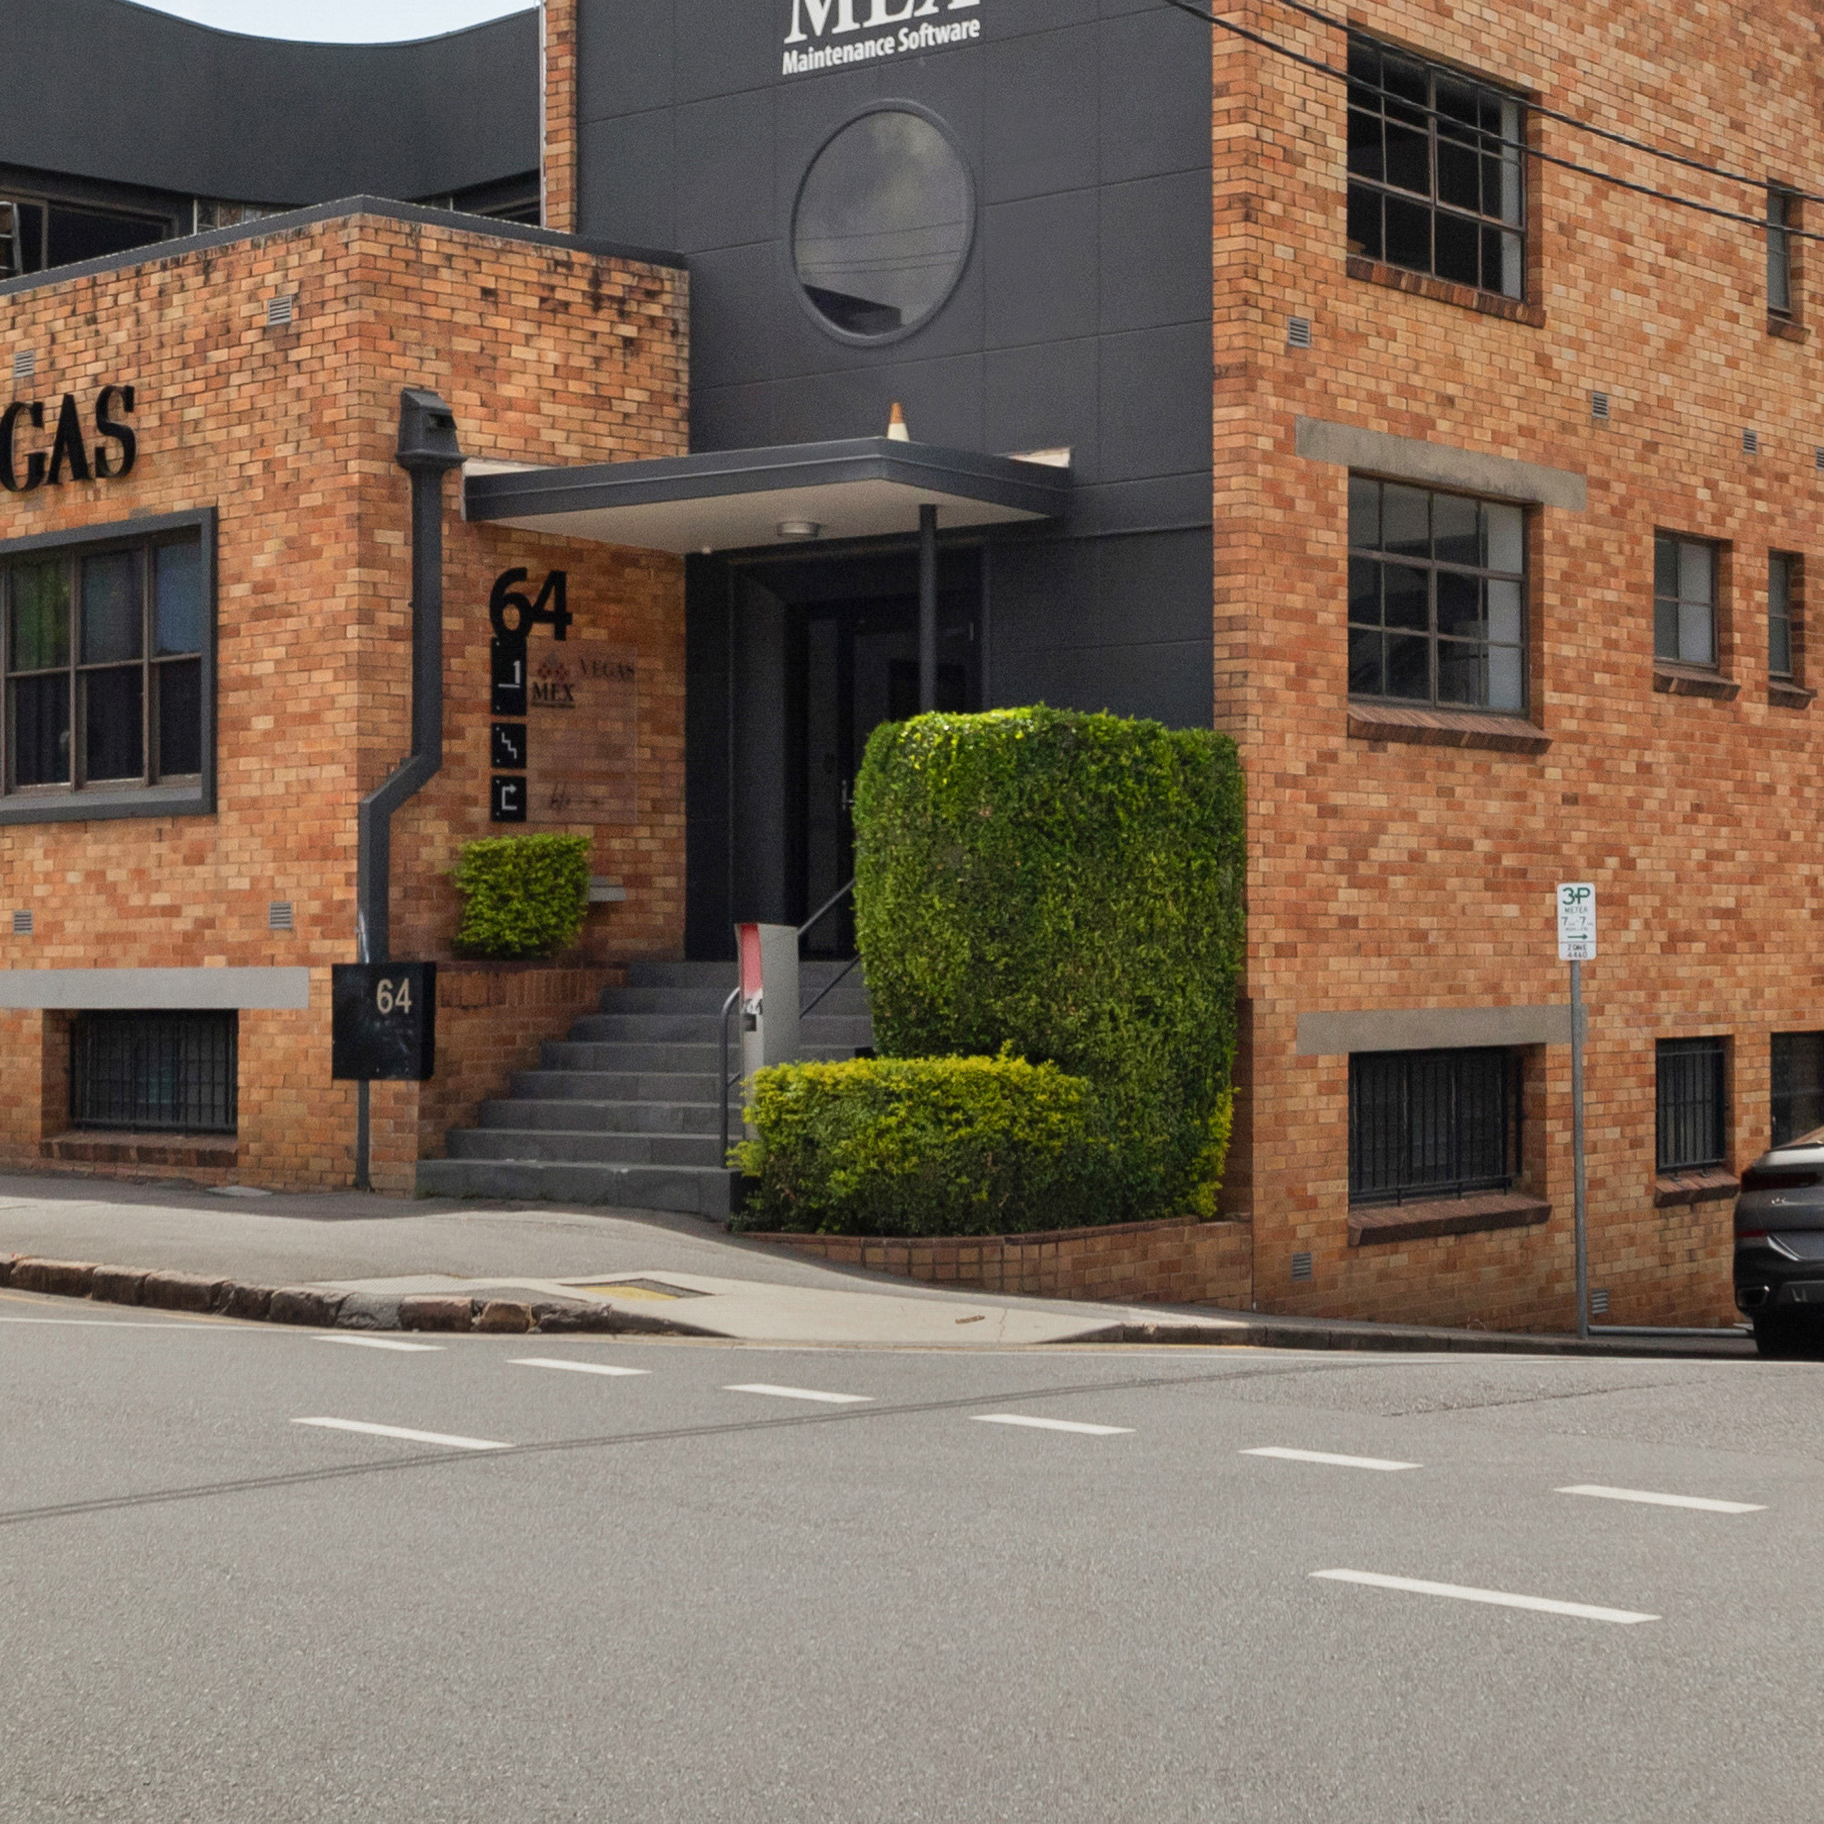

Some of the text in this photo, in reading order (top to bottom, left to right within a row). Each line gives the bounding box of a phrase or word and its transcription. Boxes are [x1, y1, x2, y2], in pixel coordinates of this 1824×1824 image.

[782, 19, 981, 75] Maintenance Software
[489, 567, 573, 641] 64
[580, 658, 636, 680] VEGAS
[532, 681, 575, 702] MEX
[377, 978, 412, 1014] 64
